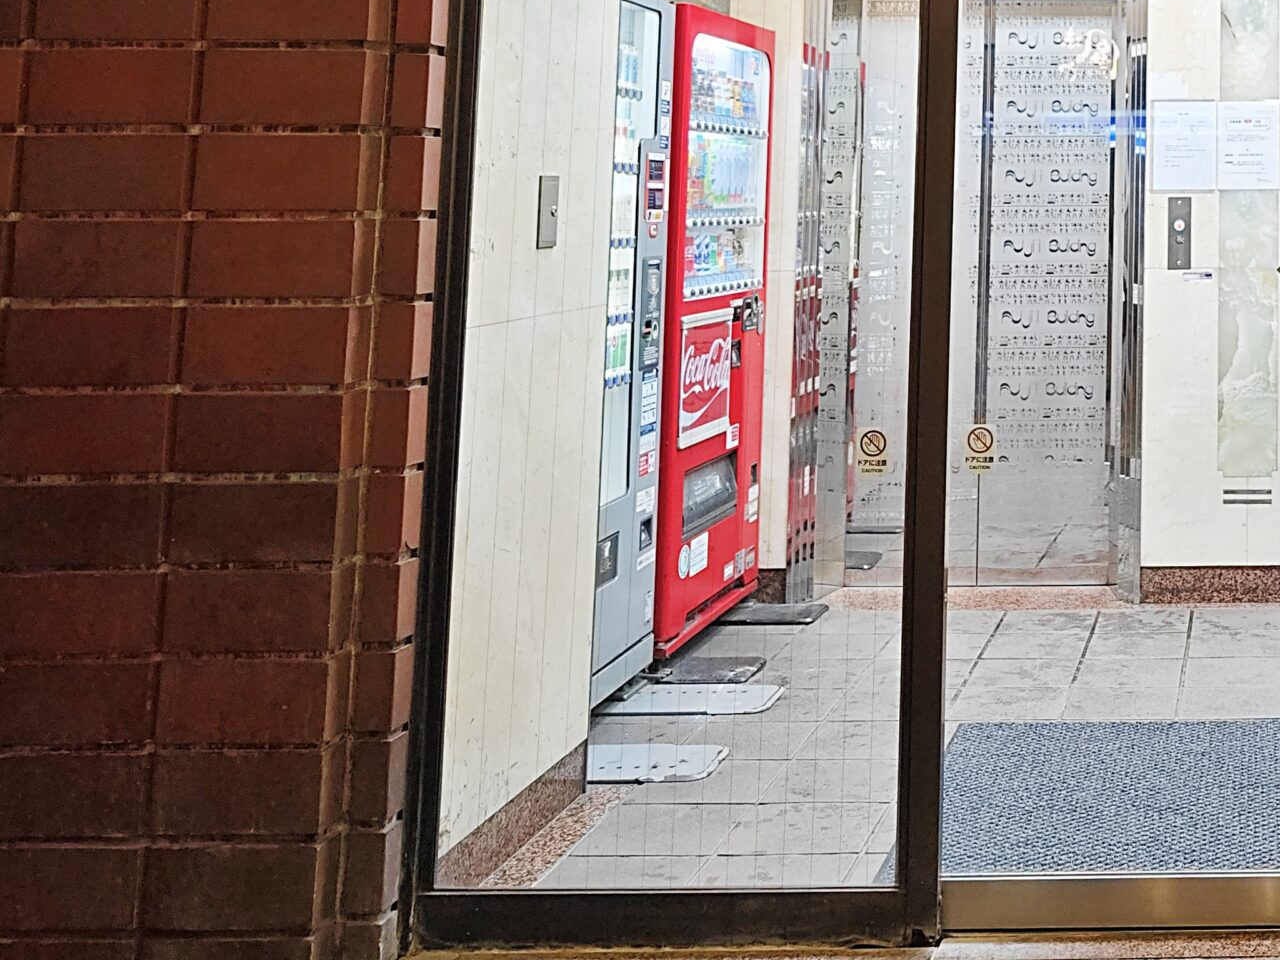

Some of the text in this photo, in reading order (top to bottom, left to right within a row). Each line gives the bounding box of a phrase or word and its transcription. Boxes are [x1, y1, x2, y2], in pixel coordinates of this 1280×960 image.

[857, 459, 887, 467] ドアに注意
[965, 456, 994, 464] ドアに注意
